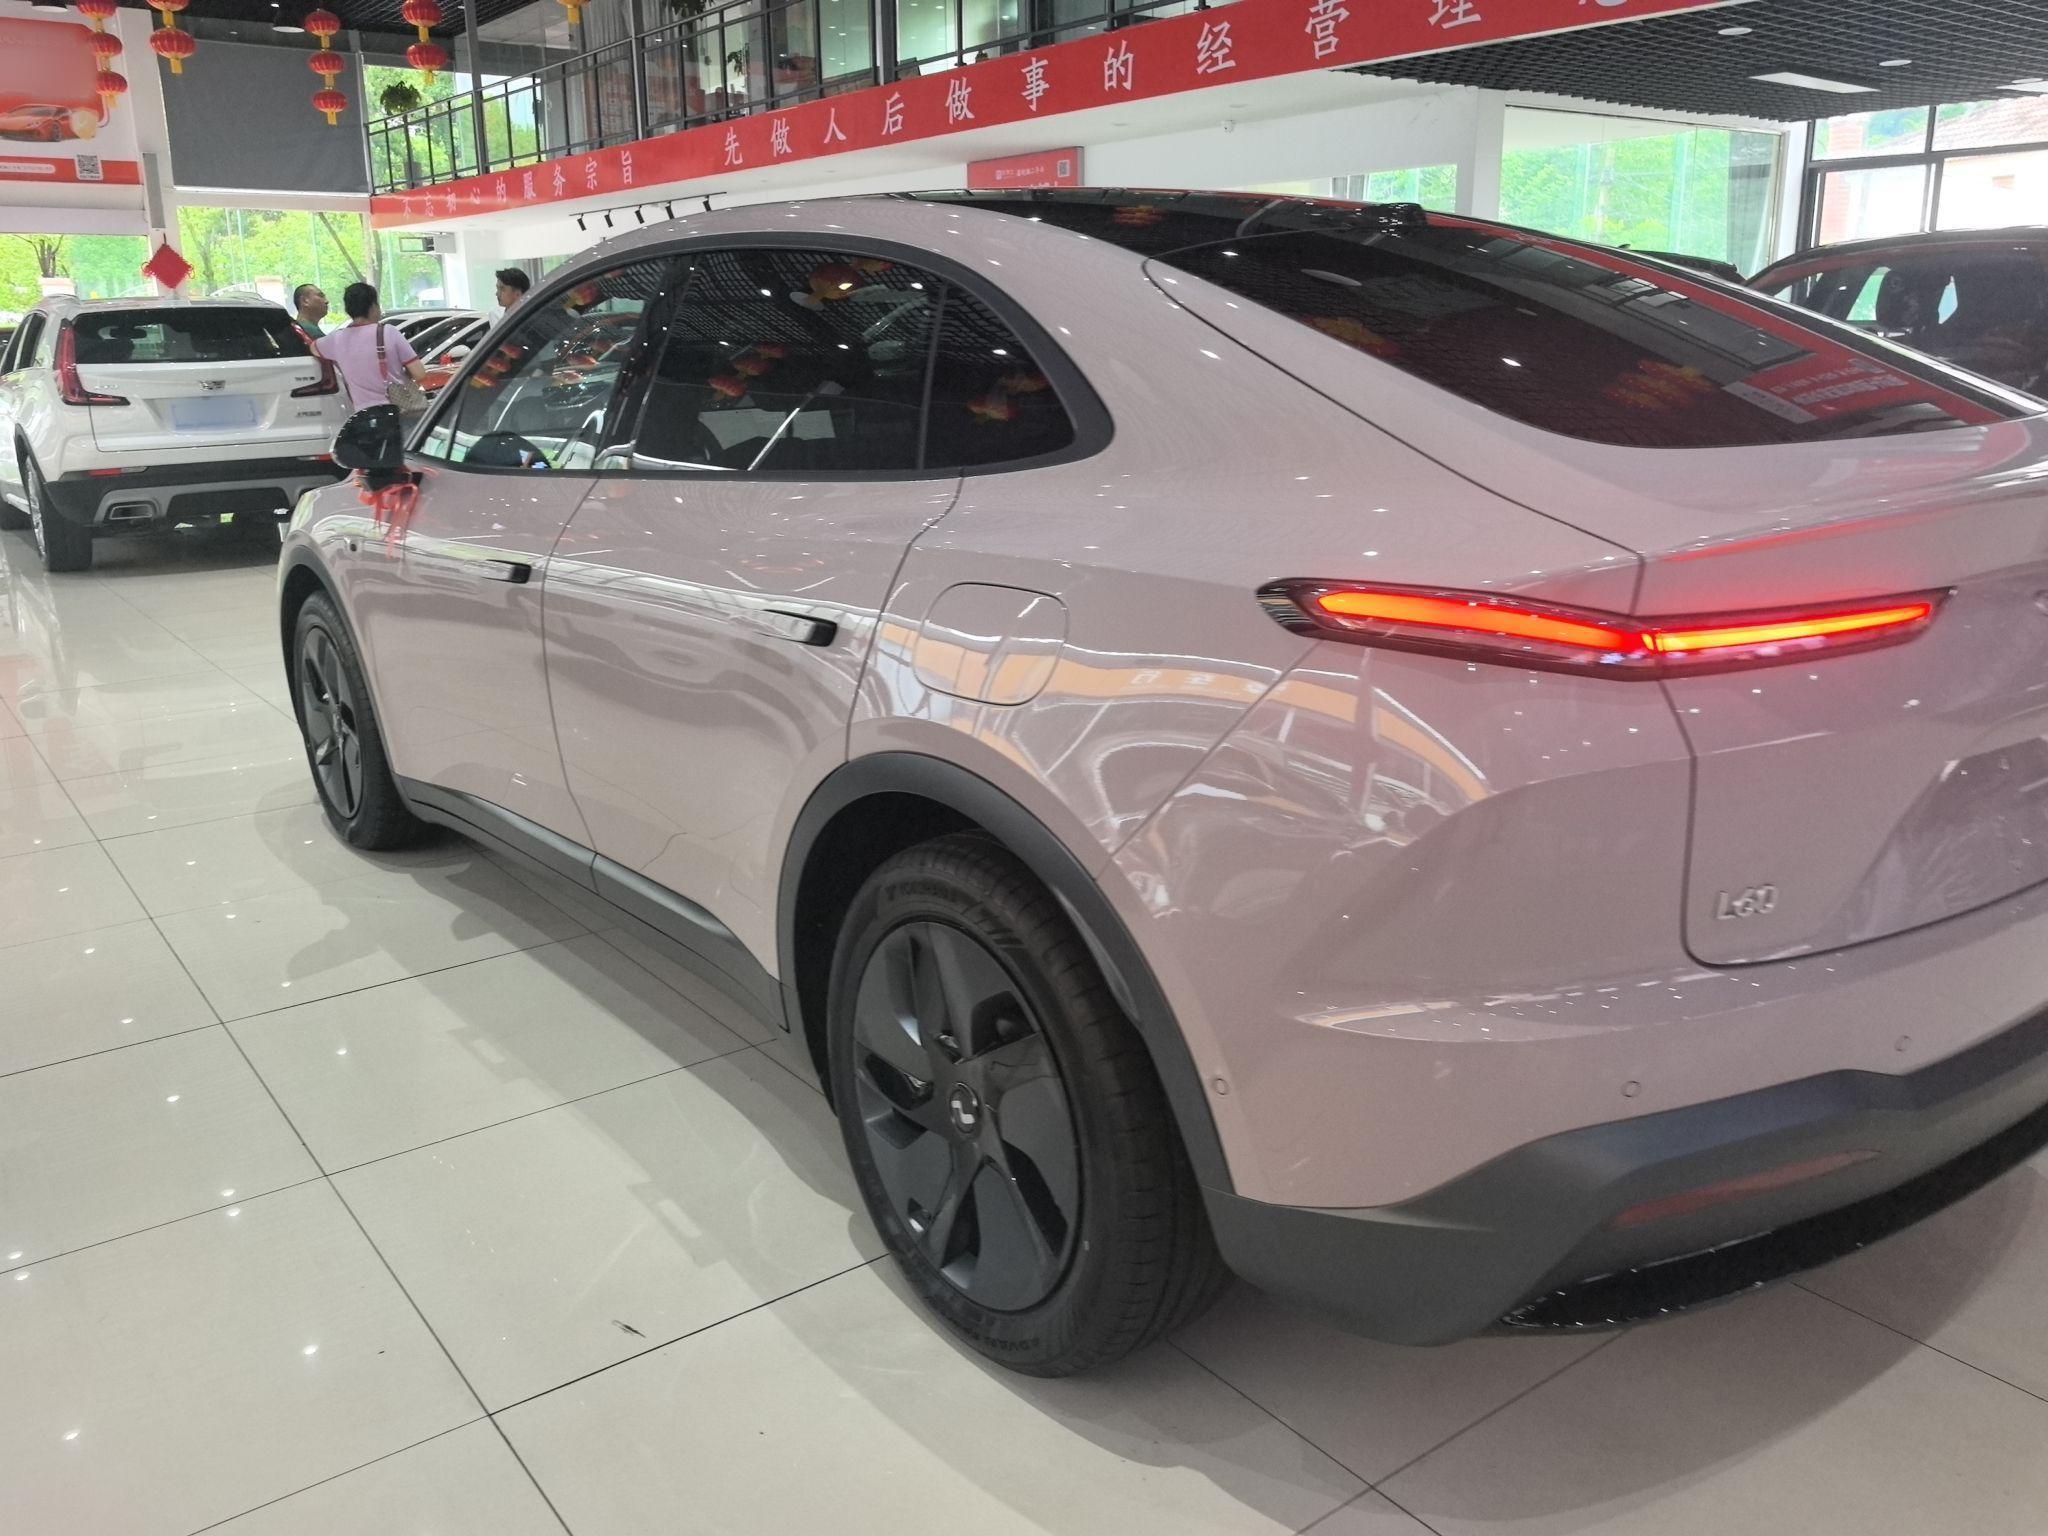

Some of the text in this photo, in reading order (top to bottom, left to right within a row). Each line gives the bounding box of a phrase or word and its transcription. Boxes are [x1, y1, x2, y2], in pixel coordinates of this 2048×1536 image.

[402, 0, 1628, 218] 不忘初心的服务宗旨 先做人后做事的经营
[1714, 884, 1778, 920] L60
